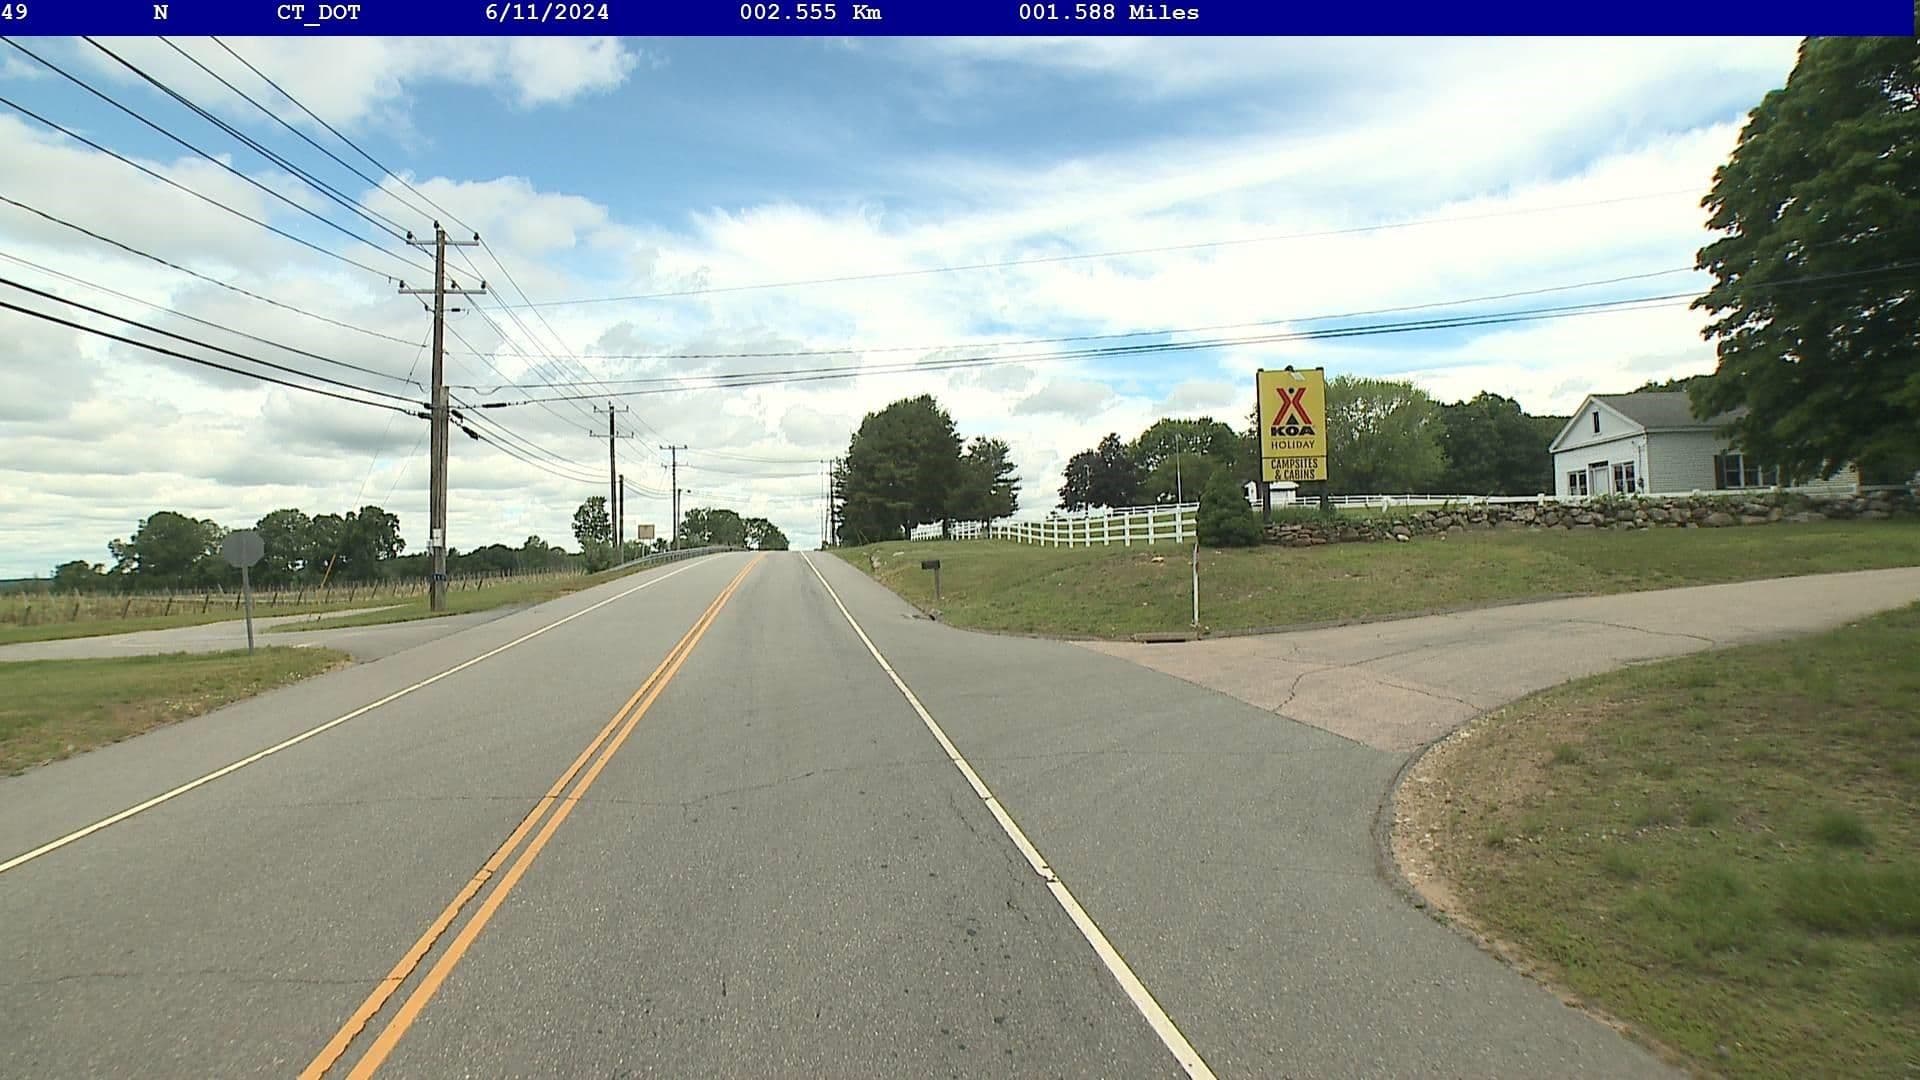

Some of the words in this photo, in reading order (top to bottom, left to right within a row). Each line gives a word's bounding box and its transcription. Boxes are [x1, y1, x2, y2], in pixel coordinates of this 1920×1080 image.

[1271, 426, 1315, 436] KOA
[1271, 440, 1315, 450] HOLIDAY
[1271, 458, 1318, 469] CAMPSITES
[1274, 470, 1281, 481] &
[1284, 469, 1315, 480] CABINS
